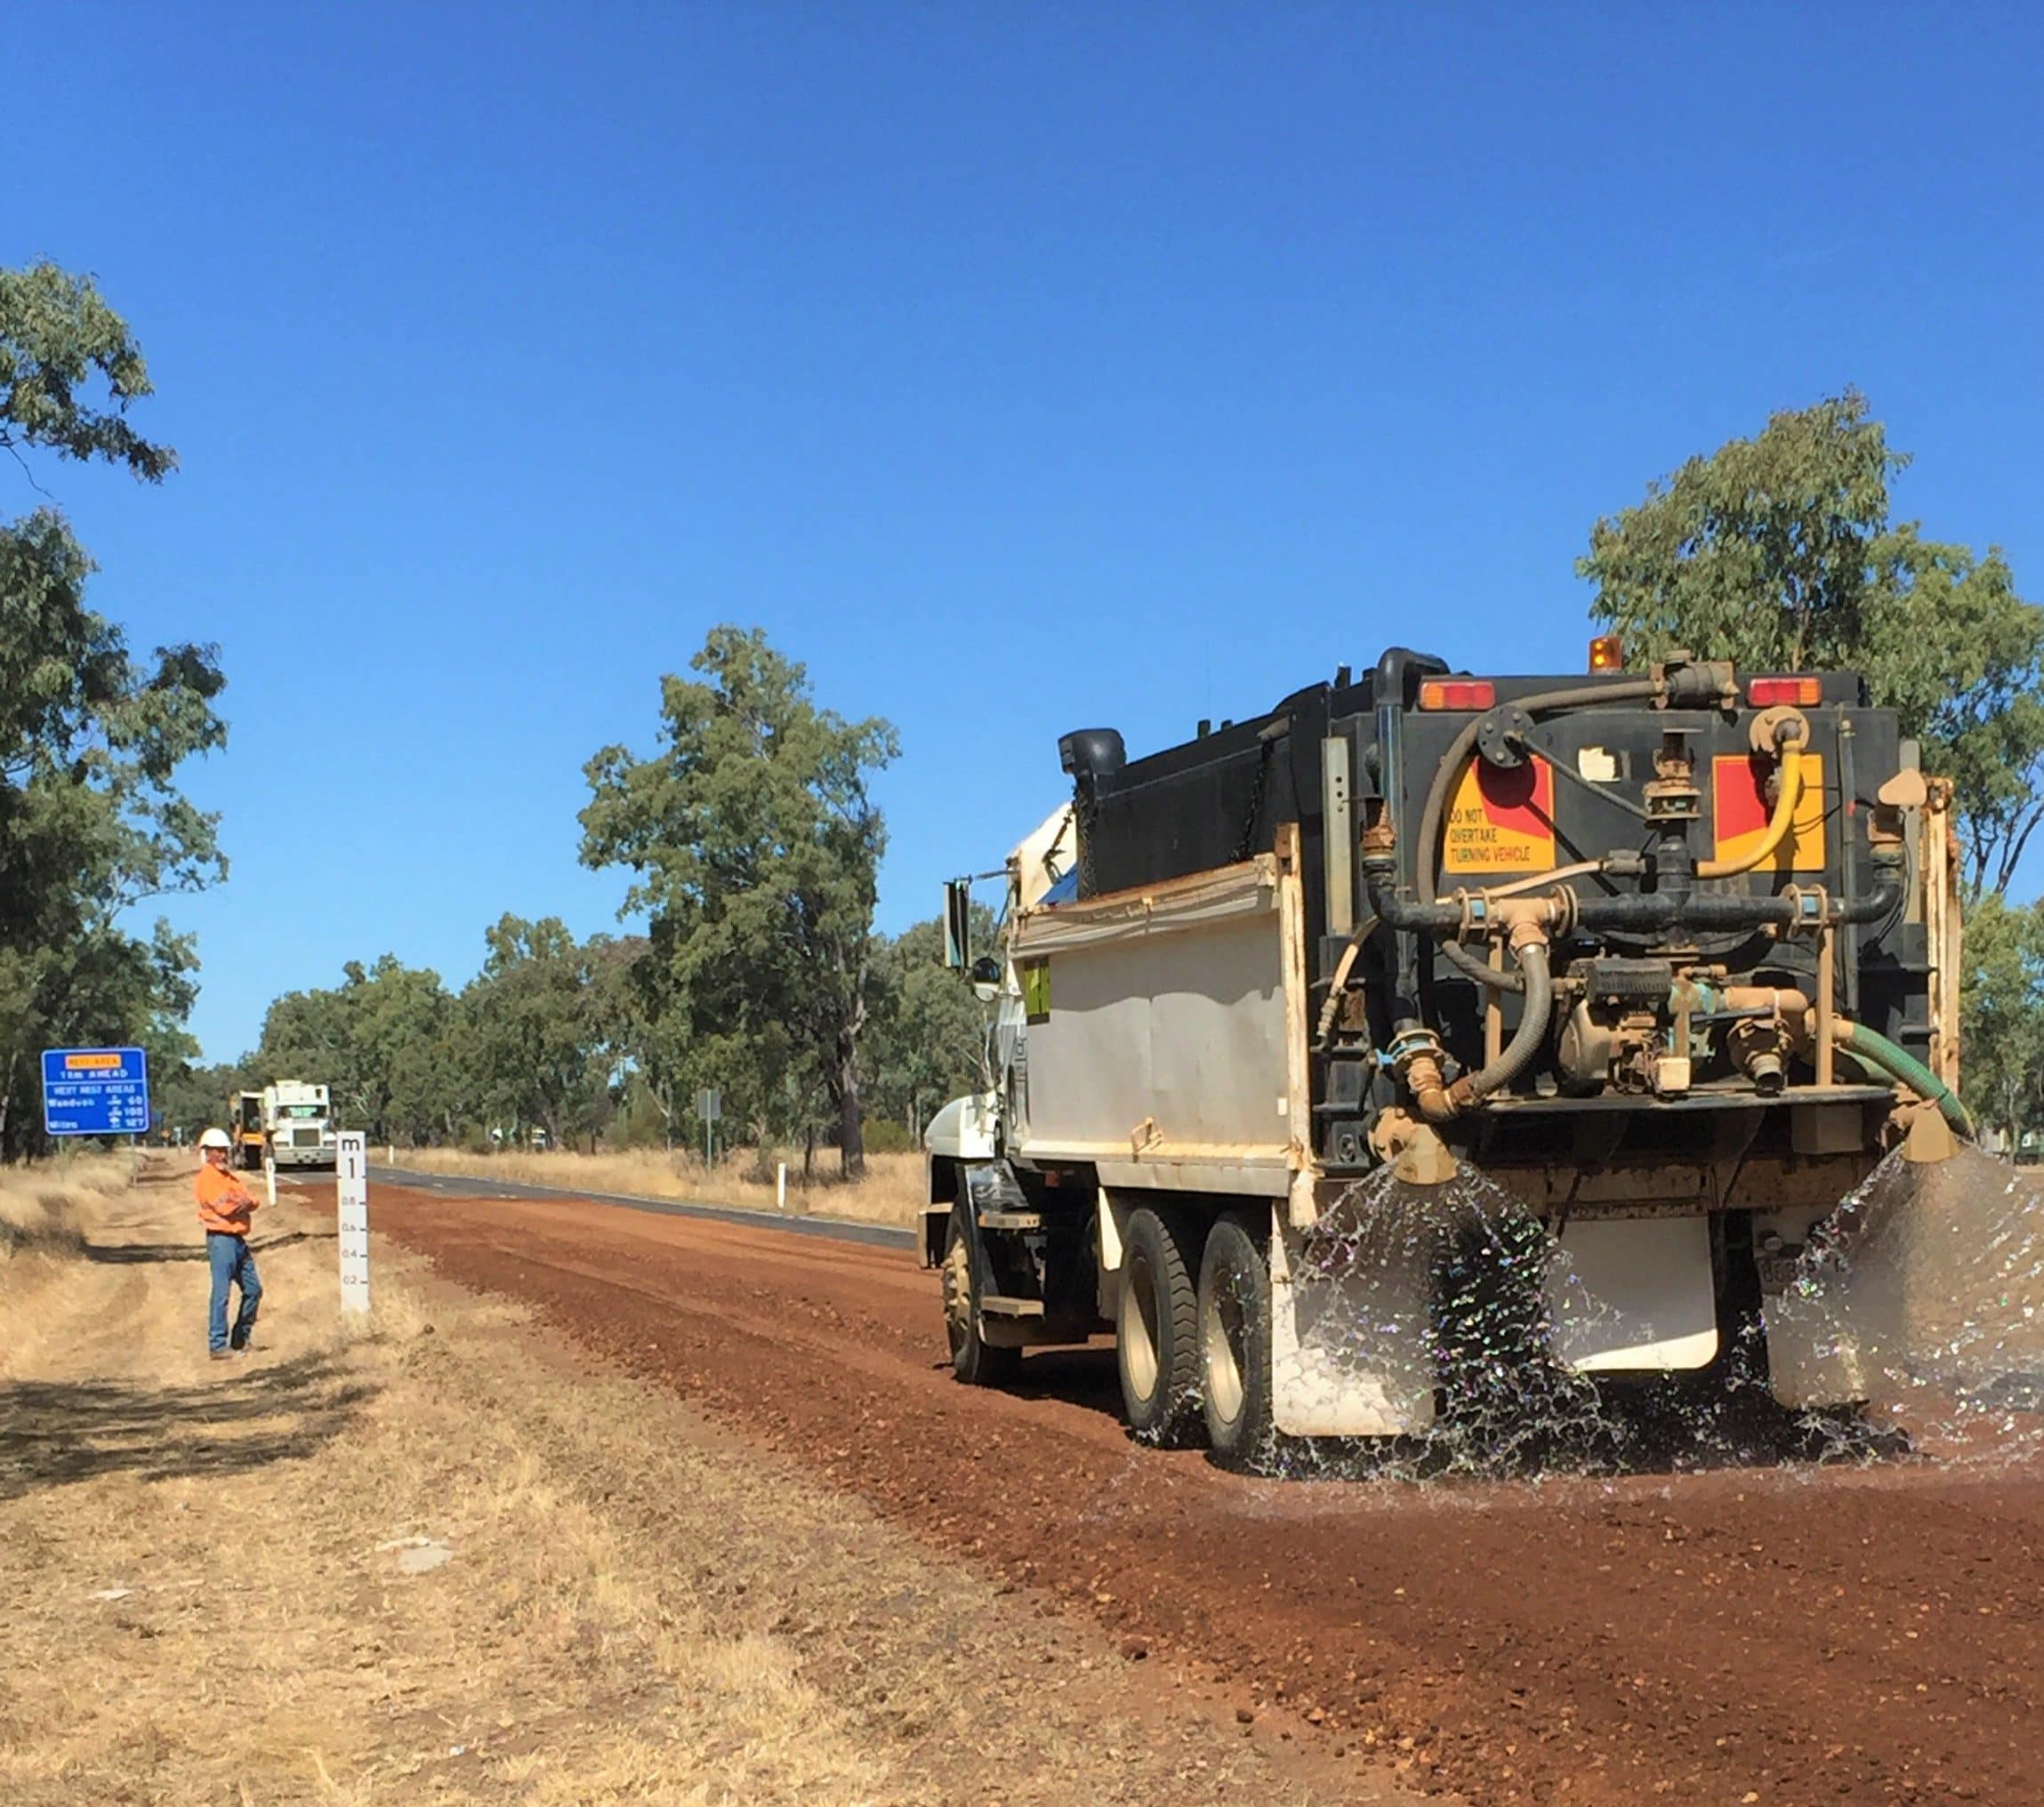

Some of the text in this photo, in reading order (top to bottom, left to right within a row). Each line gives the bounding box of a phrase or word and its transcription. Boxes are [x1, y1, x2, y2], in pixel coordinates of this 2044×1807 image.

[1466, 808, 1483, 823] NOT
[1450, 828, 1497, 843] OVERTAKE
[1451, 846, 1530, 863] TURNING VEHICLE
[88, 1069, 129, 1079] AHEAD
[105, 1084, 136, 1094] AREAS
[342, 1138, 360, 1151] m
[349, 1158, 355, 1179] 1
[342, 1249, 358, 1258] 0.4
